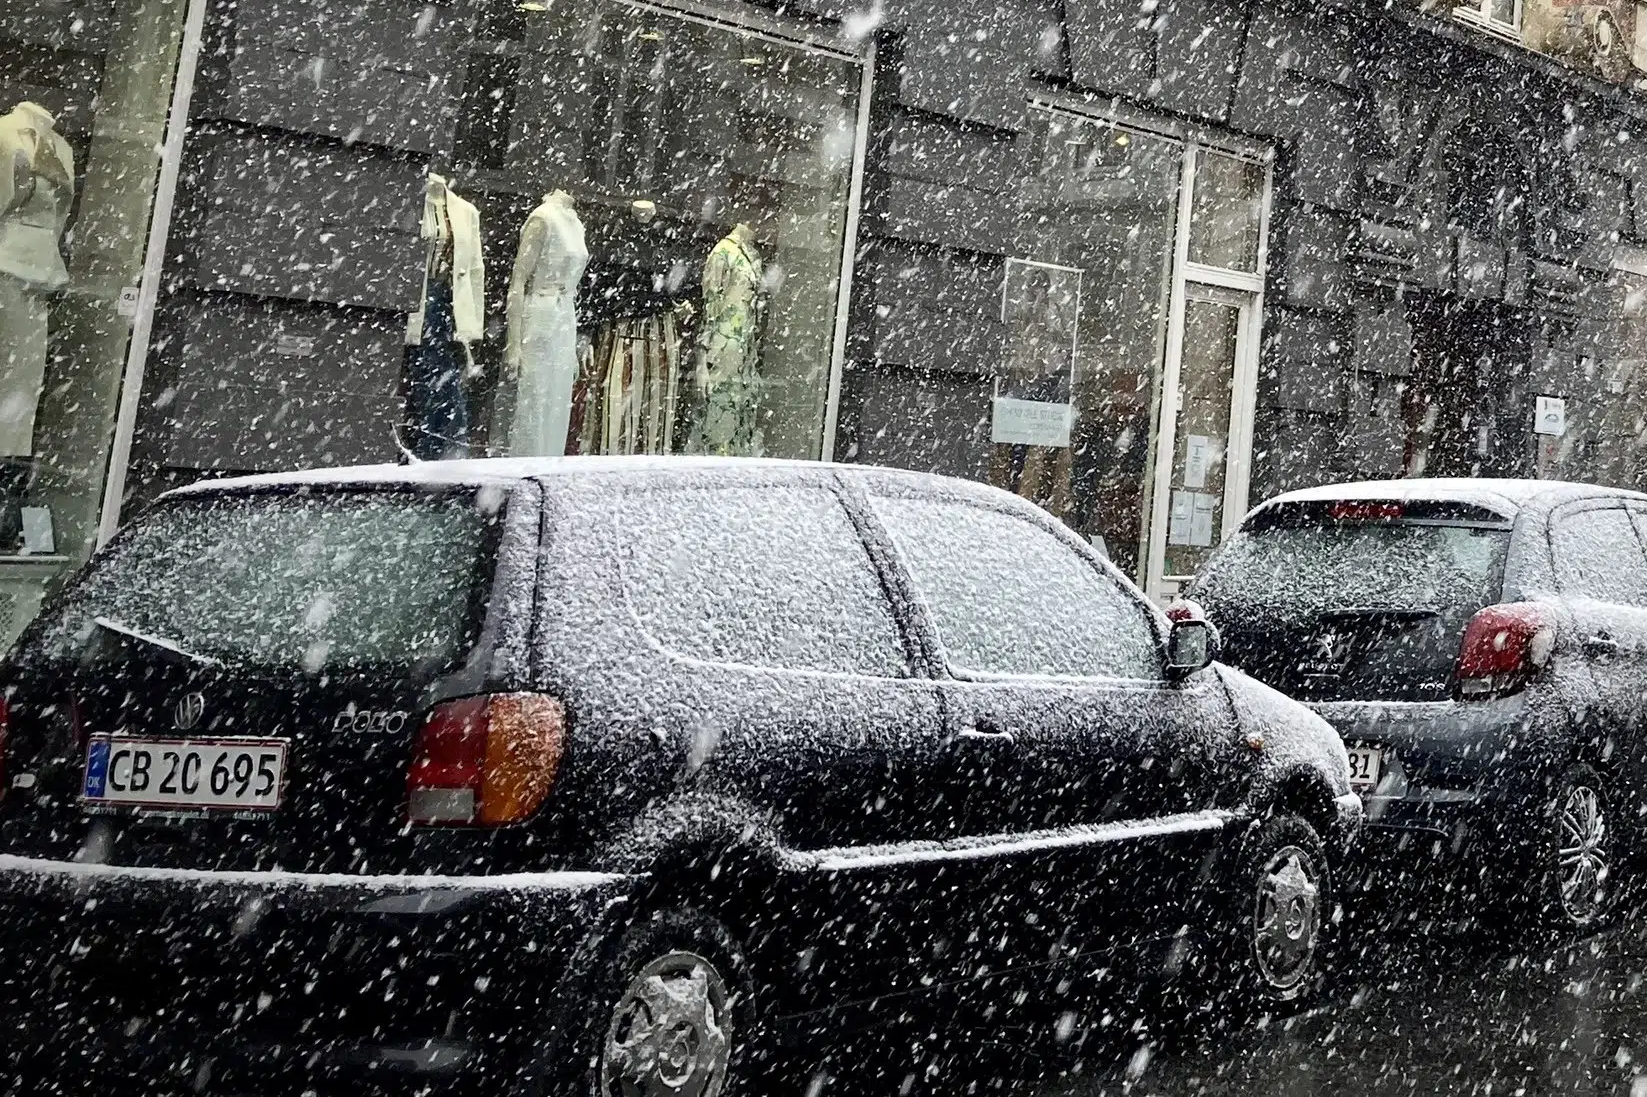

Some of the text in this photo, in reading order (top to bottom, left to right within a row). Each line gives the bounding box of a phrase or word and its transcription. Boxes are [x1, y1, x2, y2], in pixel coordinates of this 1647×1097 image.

[332, 710, 408, 733] POLO
[108, 749, 277, 798] CB 20 695
